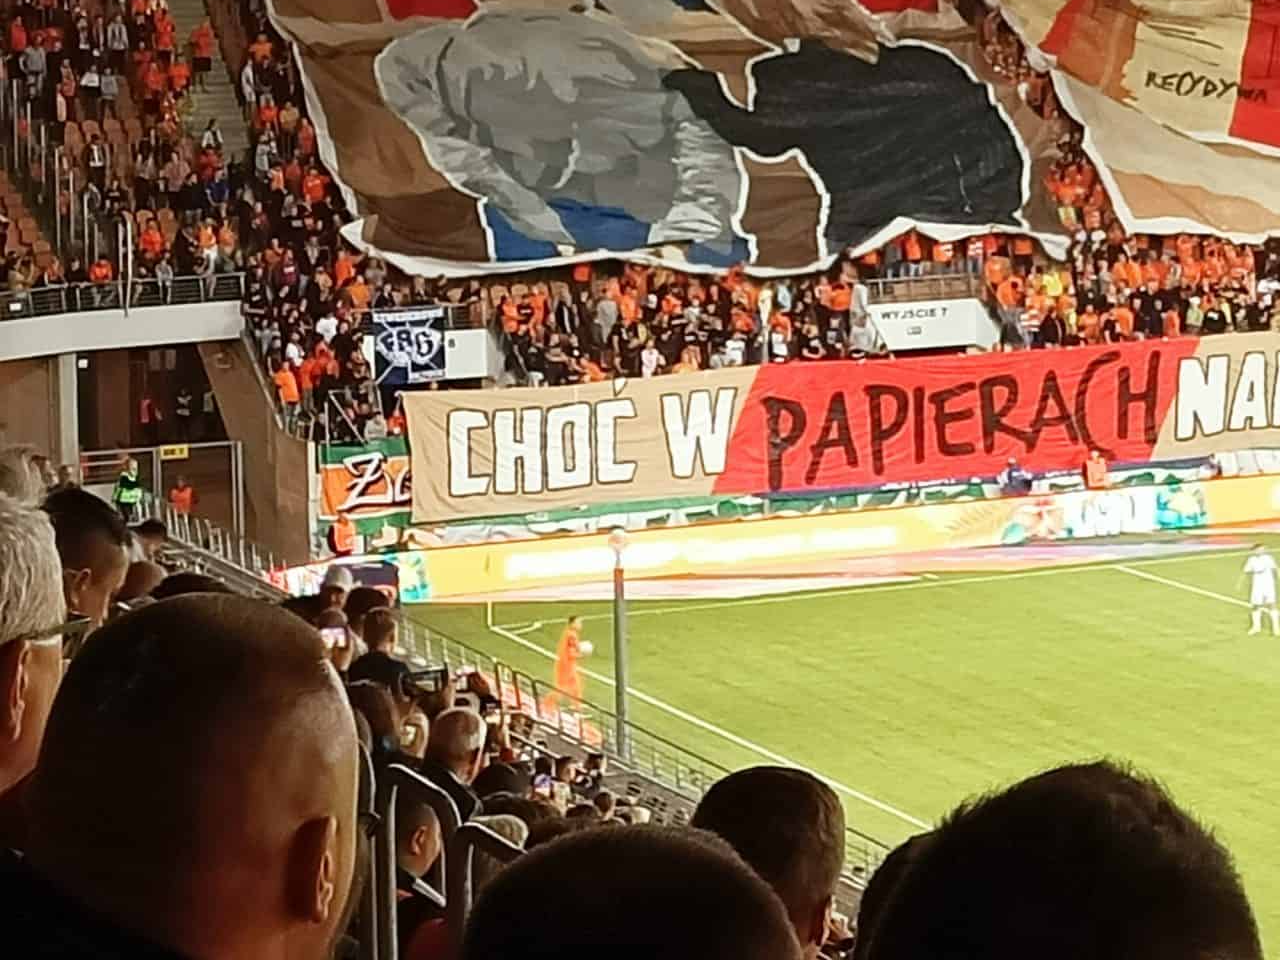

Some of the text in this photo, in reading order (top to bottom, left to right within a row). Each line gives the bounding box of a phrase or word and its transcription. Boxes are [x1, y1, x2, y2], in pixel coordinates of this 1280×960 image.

[447, 377, 638, 497] CHOĆ
[660, 387, 738, 479] W
[762, 351, 1161, 492] PAPIERACH
